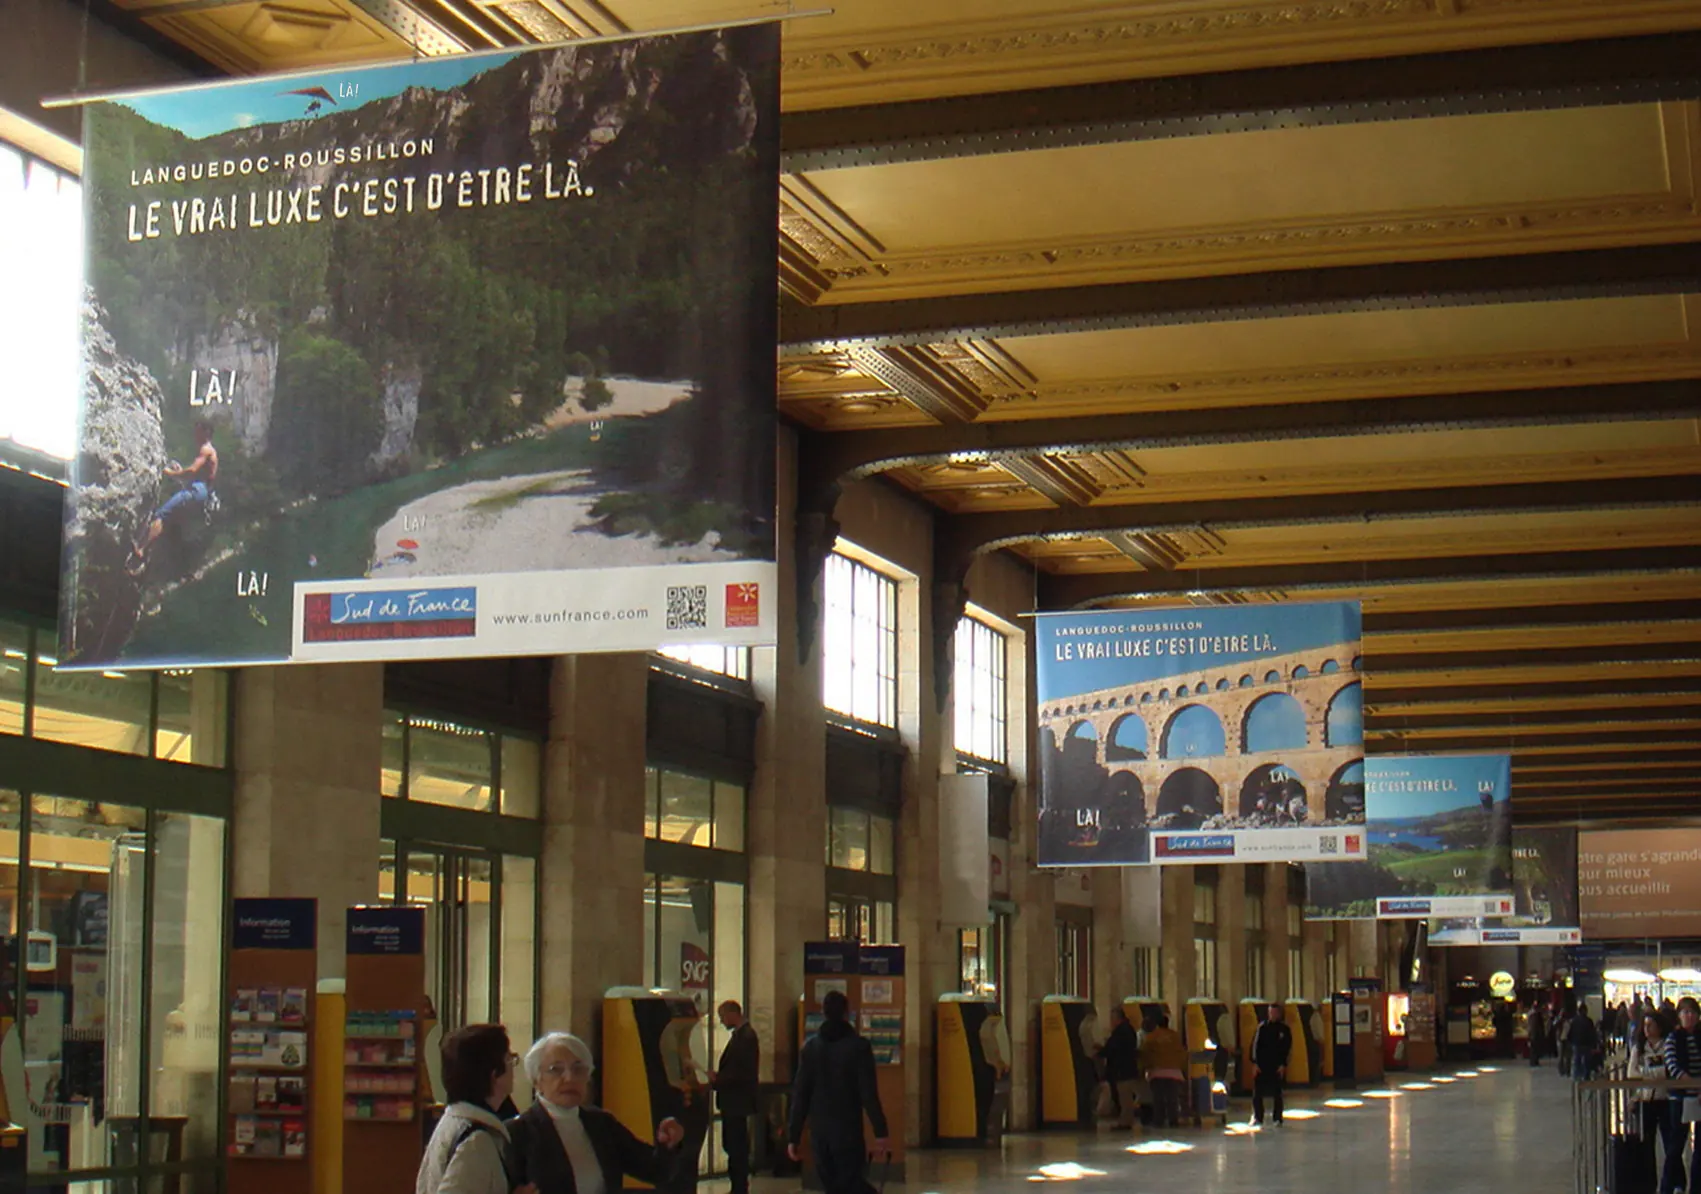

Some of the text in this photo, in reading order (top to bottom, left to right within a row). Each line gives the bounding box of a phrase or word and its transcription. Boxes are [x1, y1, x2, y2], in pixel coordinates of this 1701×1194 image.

[339, 82, 359, 98] LÀ!
[131, 138, 435, 186] LANGUEDOC-ROUSSILLON
[128, 159, 594, 242] LE VRAI LUXE C'EST D'ÊTRE LÀ.
[190, 368, 237, 406] LÀ!
[236, 570, 268, 596] LÀ!
[331, 591, 476, 624] Sud de France
[492, 607, 649, 625] www.sunfrance.com
[1055, 621, 1203, 637] LANGUEDOC-ROUSSILLON
[1055, 642, 1073, 661] LE
[1077, 641, 1110, 660] VRAI
[1115, 638, 1150, 658] LUXE
[1155, 636, 1194, 656] C'EST
[1606, 852, 1637, 865] gare
[1606, 867, 1651, 879] mieux
